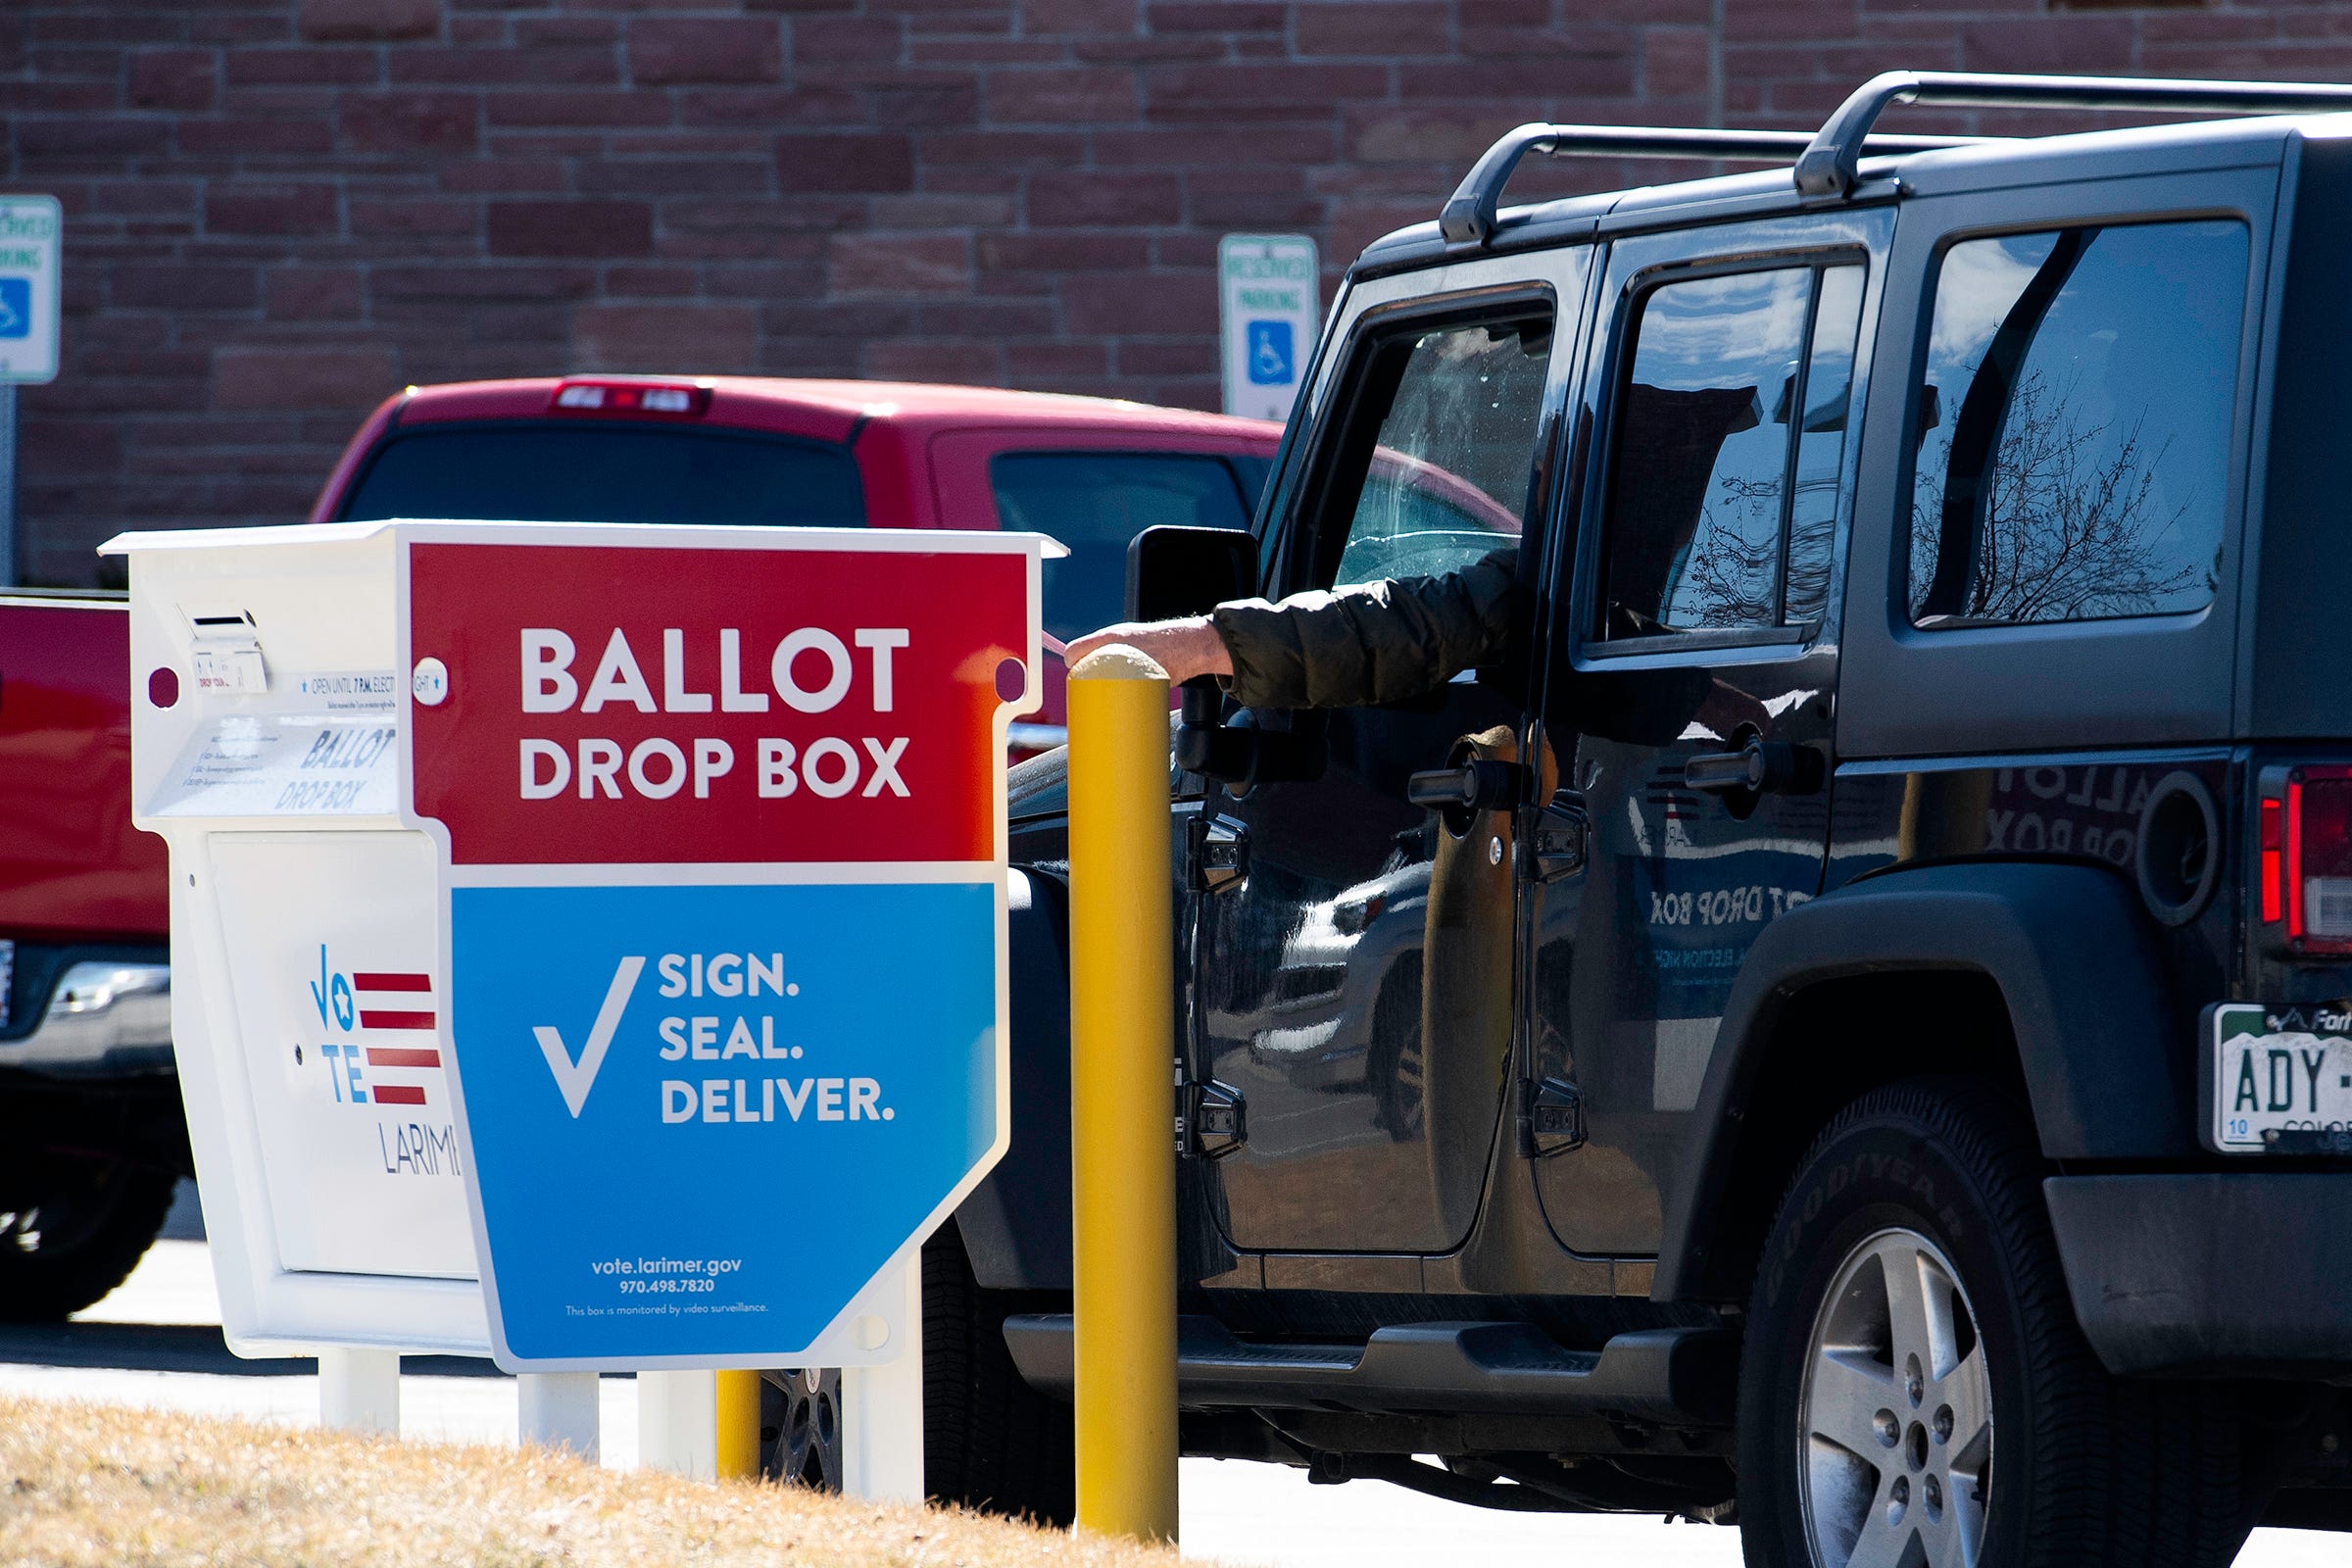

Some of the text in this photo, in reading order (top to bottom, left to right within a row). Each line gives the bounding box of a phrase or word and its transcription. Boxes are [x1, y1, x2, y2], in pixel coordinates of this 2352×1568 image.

[313, 677, 331, 694] OPEN
[333, 677, 352, 693] UNTIL
[520, 627, 909, 713] BALLOT
[300, 728, 396, 769] BALLOT
[519, 737, 910, 800] DROP BOX
[274, 780, 368, 809] DROP BOX
[659, 953, 800, 999] SIGN.
[659, 1015, 804, 1061] SEAL.
[662, 1077, 895, 1124] DELIVER.
[2229, 1119, 2248, 1135] 10
[591, 1256, 742, 1277] vote.larimer.gov
[619, 1279, 715, 1294] 970.498.7820
[565, 1301, 769, 1317] This box is monitored by video surveillance.
